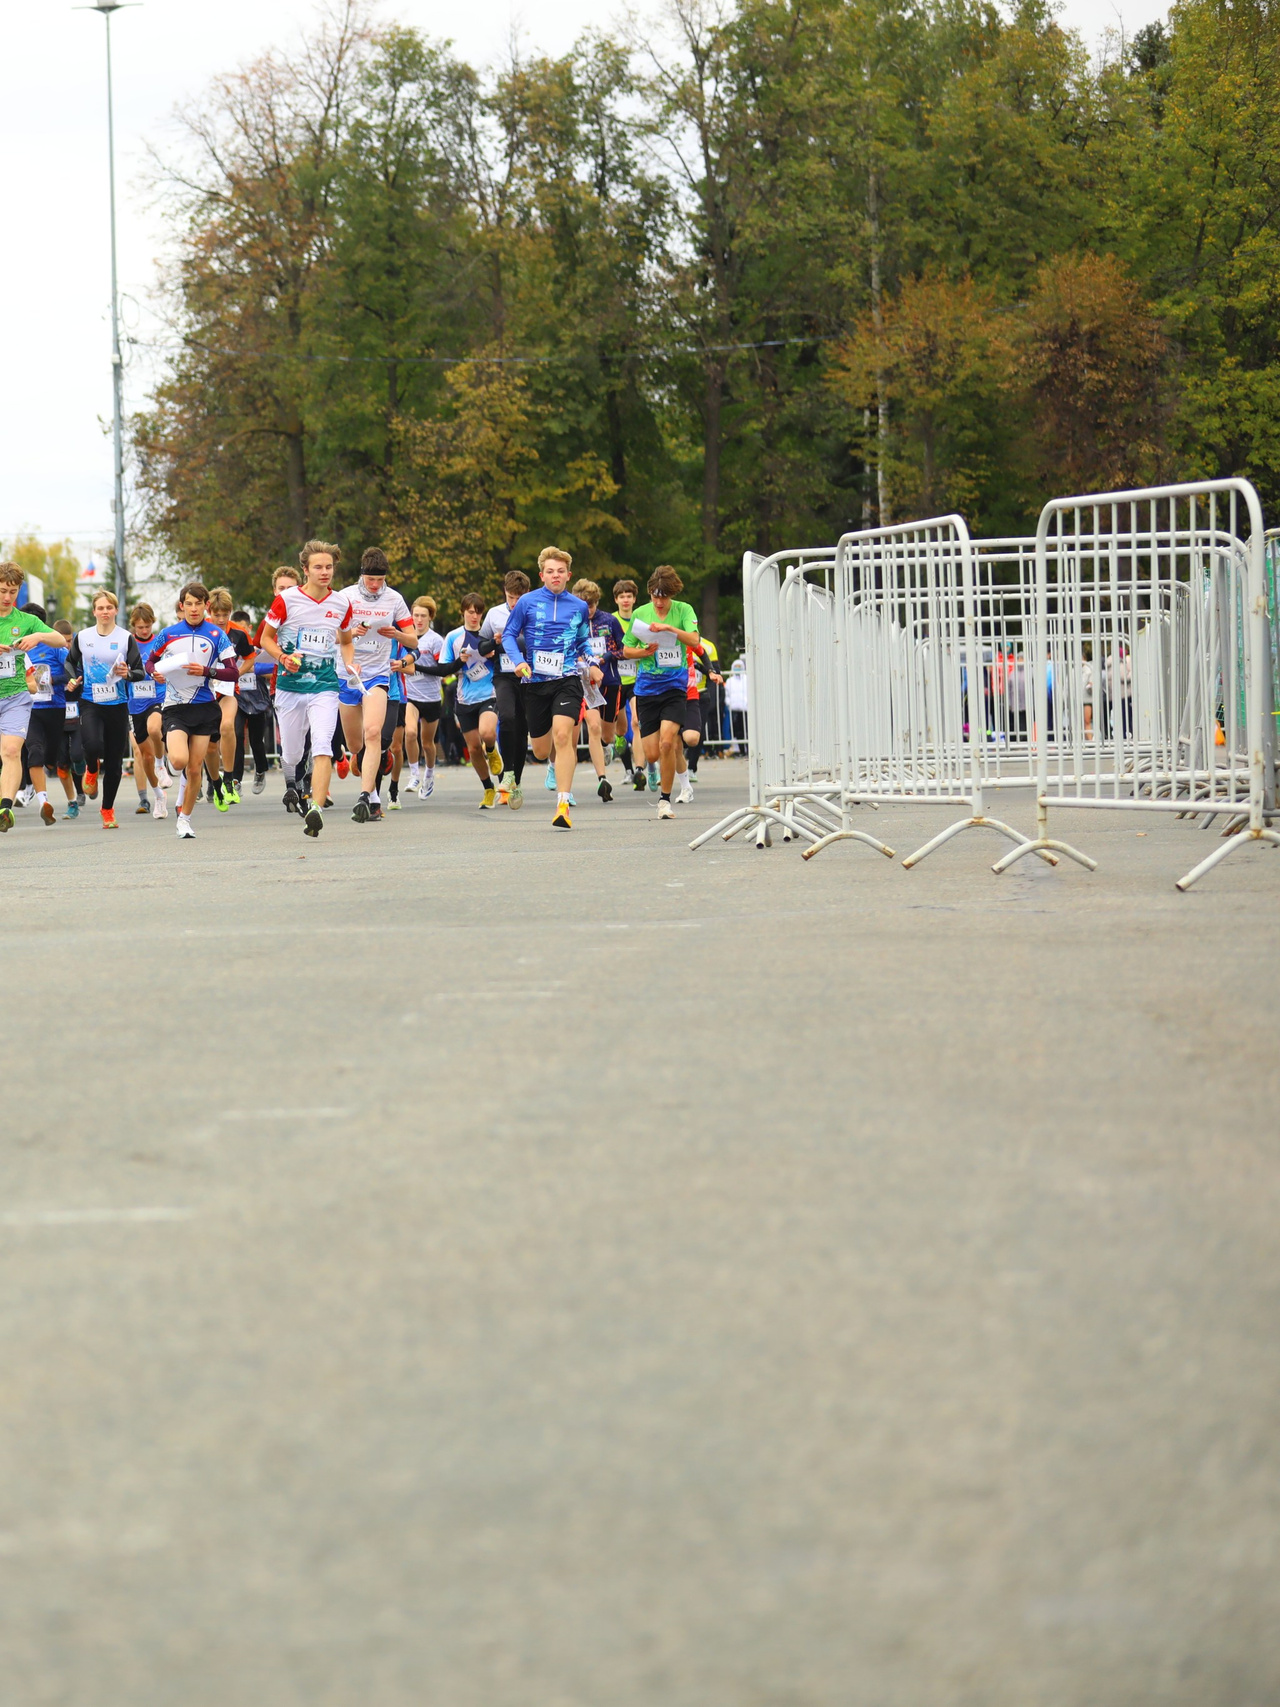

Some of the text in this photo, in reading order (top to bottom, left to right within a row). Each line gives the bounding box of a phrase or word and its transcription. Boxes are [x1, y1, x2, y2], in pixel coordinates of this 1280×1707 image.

[302, 634, 325, 643] 314.1
[659, 650, 680, 659] 320.1
[536, 655, 559, 667] 339.1
[96, 686, 115, 694] 333.1
